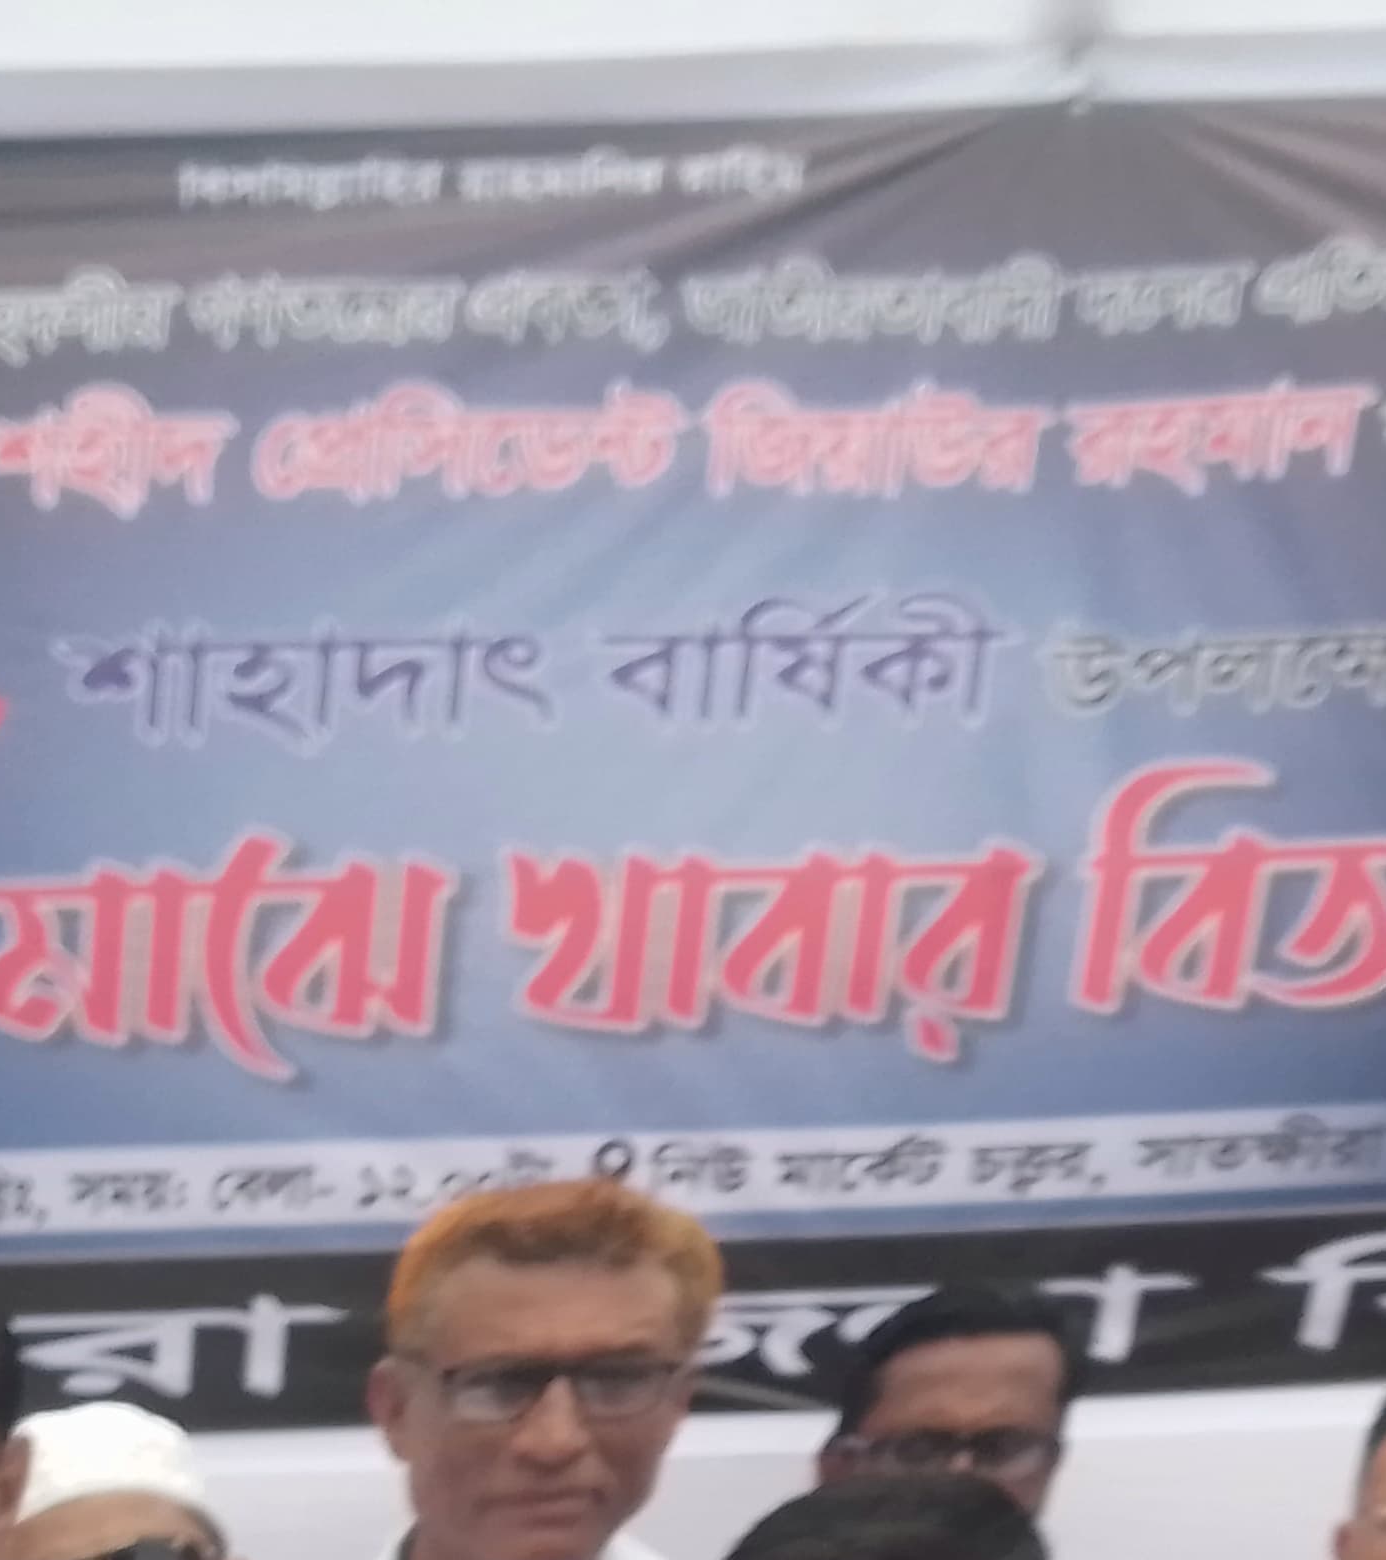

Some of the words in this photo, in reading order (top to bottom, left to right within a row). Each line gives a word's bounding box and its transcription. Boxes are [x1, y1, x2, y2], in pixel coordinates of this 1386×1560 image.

[249, 376, 689, 510] প্রেসিডেন্ট
[703, 380, 1055, 500] জিয়াউর
[1059, 374, 1381, 498] রহমান
[59, 618, 557, 756] শাহাদাৎ
[605, 592, 1013, 730] বার্ষিকী
[503, 842, 1043, 1060] খাবার
[777, 1134, 947, 1194] মার্কেট
